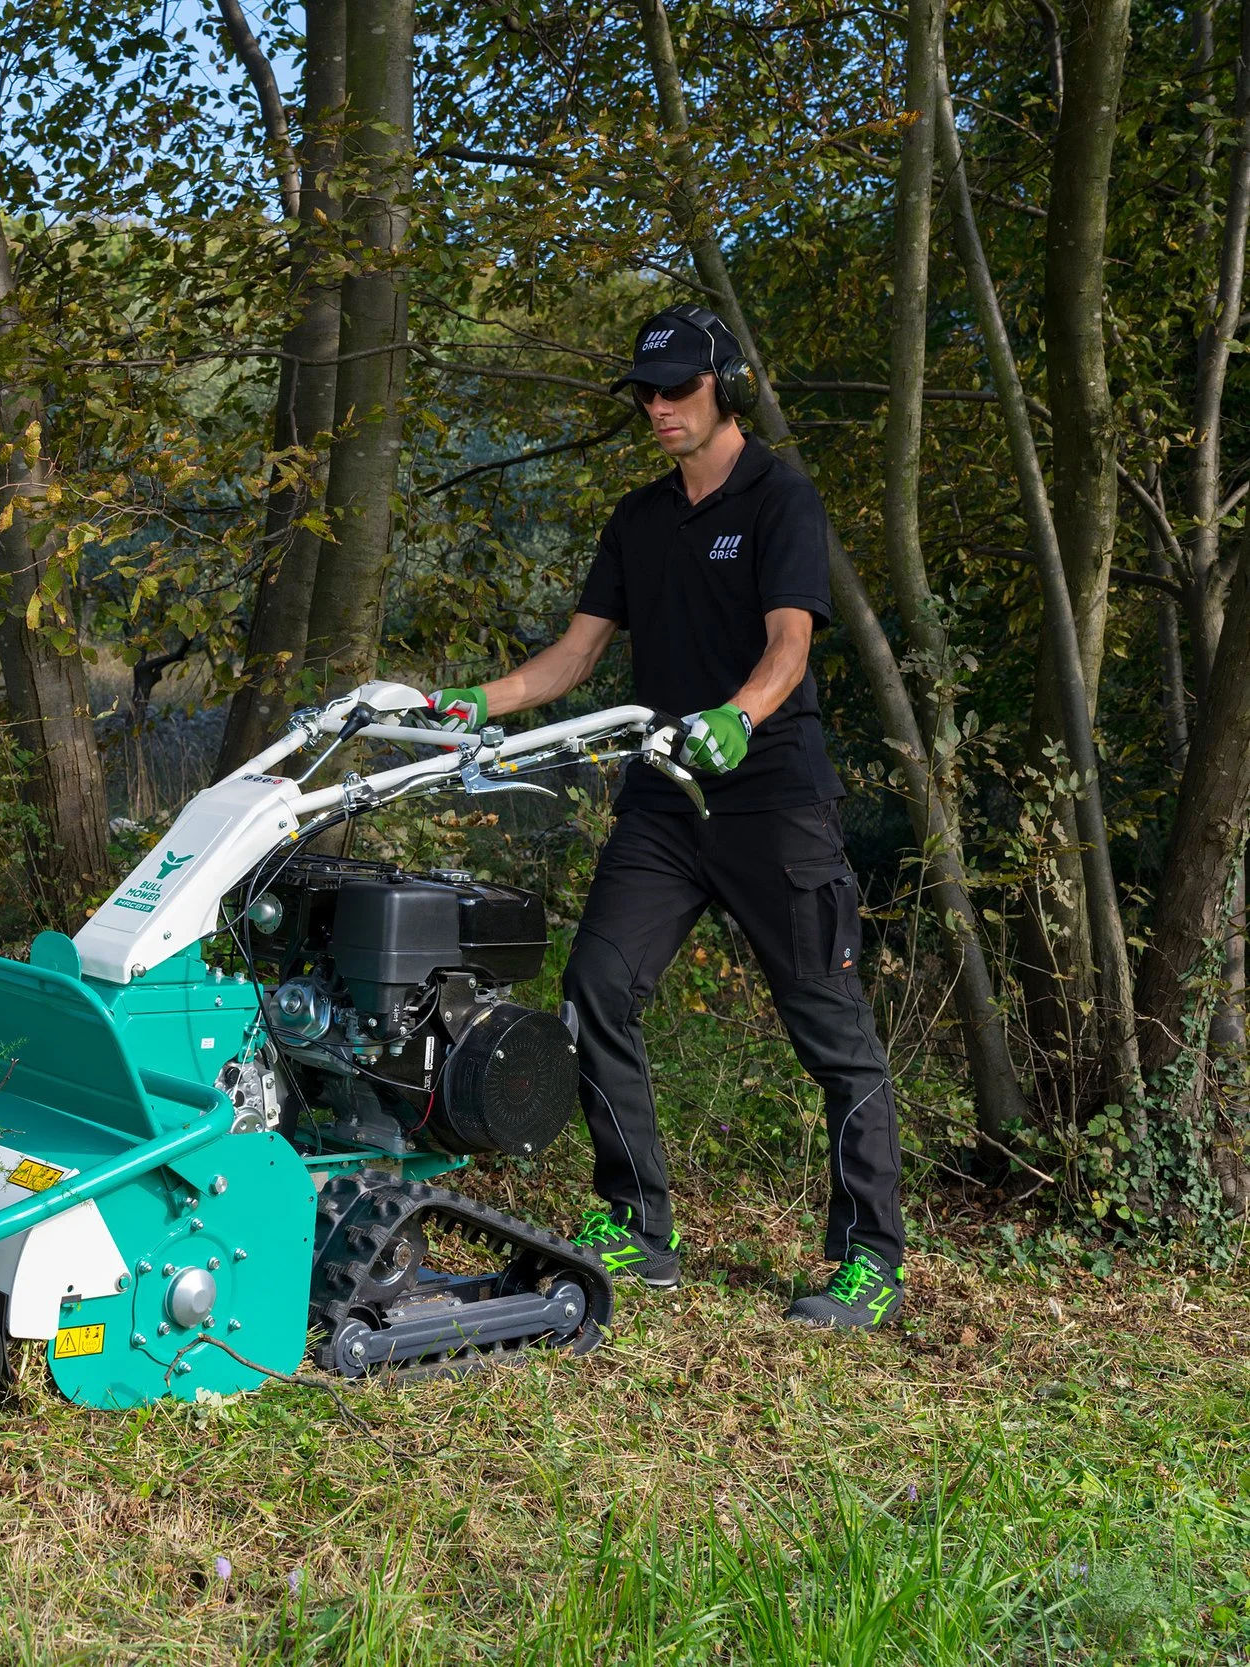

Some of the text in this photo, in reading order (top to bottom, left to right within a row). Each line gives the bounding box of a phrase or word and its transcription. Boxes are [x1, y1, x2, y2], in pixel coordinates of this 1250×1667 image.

[642, 340, 667, 351] OREC
[709, 549, 738, 560] OREC
[139, 880, 163, 892] BULL
[125, 887, 161, 902] MOWER
